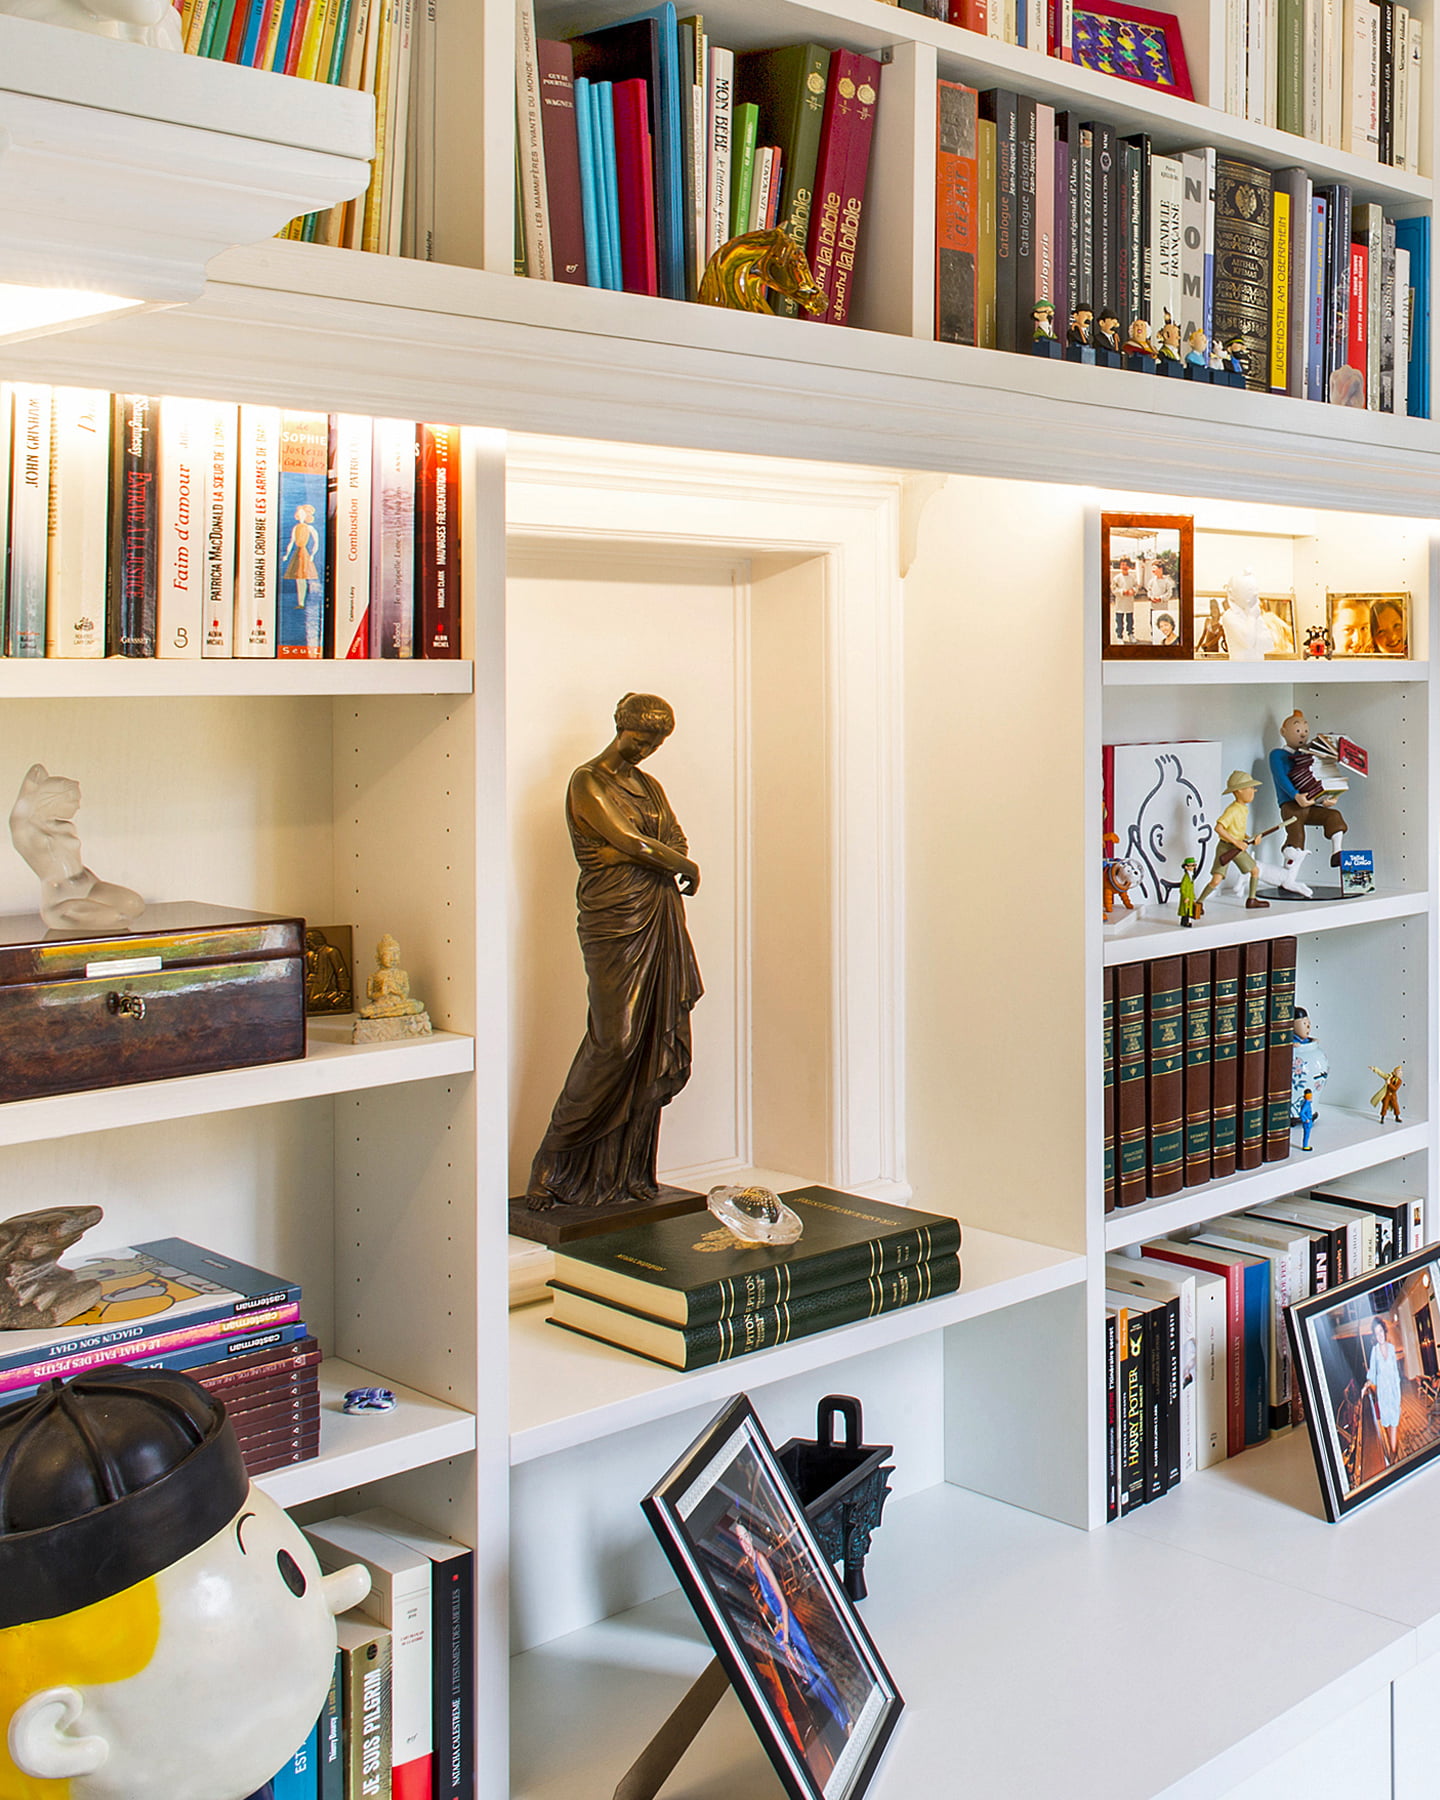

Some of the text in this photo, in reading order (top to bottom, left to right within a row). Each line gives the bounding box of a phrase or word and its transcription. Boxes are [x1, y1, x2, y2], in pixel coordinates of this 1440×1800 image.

[427, 7, 436, 23] LES
[714, 77, 729, 111] MON
[521, 11, 543, 229] LES MAMMIFÈRES VIVANTS DU MONDE HACHETTE
[1369, 113, 1377, 131] Hugh
[1008, 111, 1017, 196] Jean-Jacques Henner
[1028, 111, 1037, 195] Jean-Jacques Henner
[1069, 158, 1078, 195] d'Alsace
[789, 187, 812, 243] bible
[998, 140, 1011, 259] Catalogue raisonné
[1018, 140, 1031, 257] Catalogue raisonné
[1069, 196, 1079, 236] régionale
[818, 192, 841, 247] bible
[1159, 199, 1170, 276] LA PENDULE
[815, 247, 833, 267] la
[832, 197, 862, 321] aujourd'hui la bible
[1069, 238, 1079, 266] langue
[1170, 202, 1181, 278] FRANÇAISE
[1039, 232, 1050, 301] horlogerie
[1275, 216, 1287, 374] JUGENDSTIL AM OBERRHEIN
[1384, 276, 1395, 321] Breguet
[25, 398, 40, 489] JOHN GRISHAM
[282, 430, 327, 447] SOPHIE
[284, 444, 325, 458] Jostein
[255, 460, 267, 495] LARMES
[283, 456, 326, 470] Gaarder
[128, 470, 152, 523] ENTRAVE
[212, 491, 224, 502] LA
[255, 498, 267, 514] LES
[128, 536, 145, 550] LA
[172, 463, 191, 592] Faim d'amour
[254, 517, 267, 556] CROMBIE
[348, 497, 359, 562] Combustion
[126, 552, 145, 599] JUSTICE
[210, 562, 223, 602] PATRICIA
[254, 558, 267, 599] DEBORAH
[393, 559, 404, 596] m'appelle
[282, 646, 321, 657] Seuil
[235, 1293, 287, 1312] casterman
[744, 1275, 755, 1306] PITON
[48, 1326, 144, 1356] CHACUN SON CHAT
[222, 1312, 278, 1332] casterman
[744, 1314, 755, 1345] PITON
[33, 1339, 161, 1377] LE CHAT FAIT DES PETITS
[229, 1333, 281, 1353] casterman
[1128, 1365, 1140, 1466] HARRY POTTER
[451, 1588, 461, 1626] ABEILLES
[451, 1638, 461, 1684] TESTAMENT
[328, 1739, 338, 1763] Thierry
[362, 1668, 381, 1796] JE SUIS PILGRIM
[294, 1749, 307, 1774] EST
[451, 1749, 461, 1787] NATACHA
